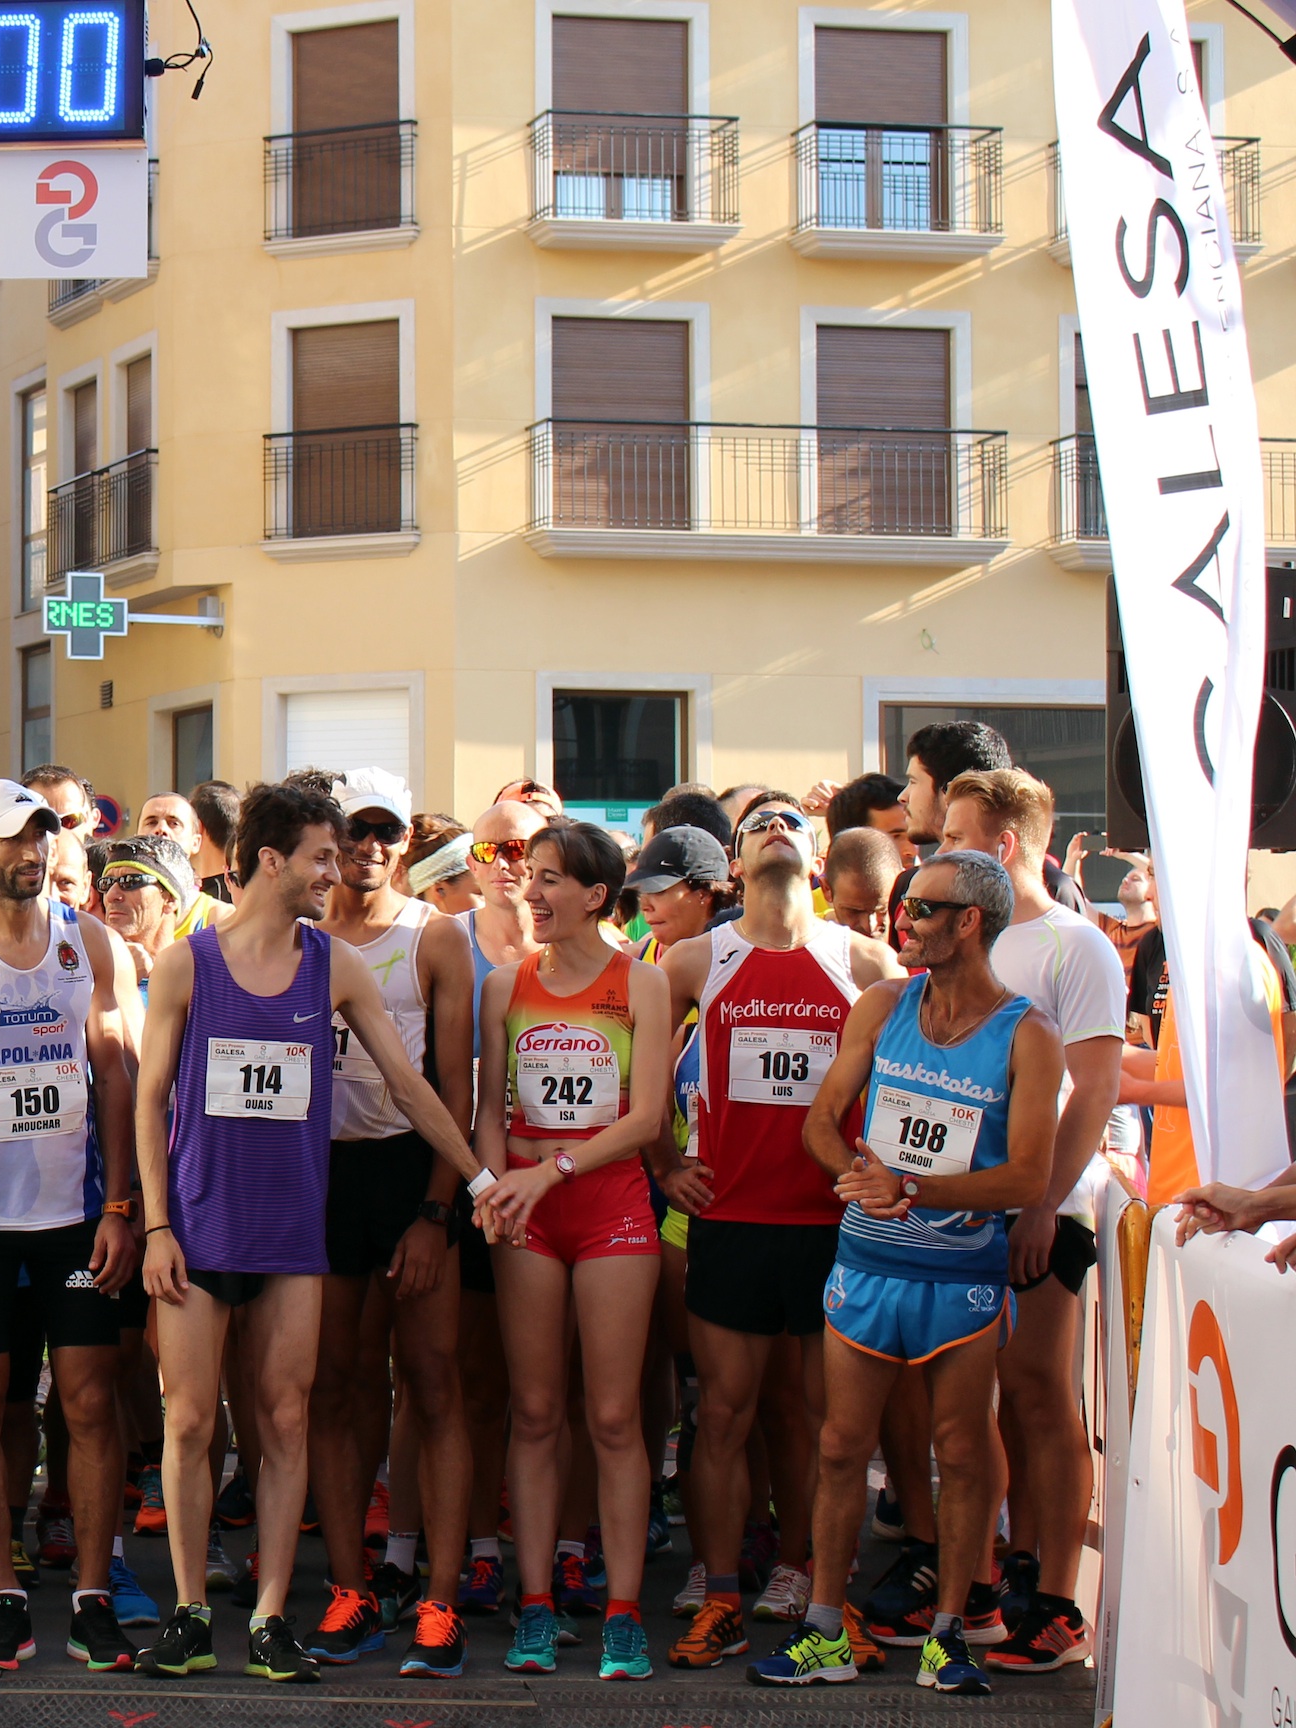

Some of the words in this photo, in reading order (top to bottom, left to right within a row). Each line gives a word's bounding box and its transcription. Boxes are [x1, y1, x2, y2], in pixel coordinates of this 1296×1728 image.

[591, 1003, 629, 1013] SERRANO
[720, 998, 841, 1024] Mediterránea
[32, 1023, 64, 1037] sport
[521, 1034, 601, 1051] Serrano
[737, 1036, 768, 1044] GALESA
[809, 1035, 833, 1047] 10K
[215, 1048, 245, 1056] GALESA
[285, 1046, 307, 1058] 10K
[589, 1056, 614, 1067] 10K
[759, 1051, 809, 1081] 103
[55, 1063, 79, 1075] 10K
[56, 1073, 80, 1081] CHESTE
[239, 1064, 282, 1094] 114
[874, 1055, 1004, 1103] maskokotas
[541, 1076, 593, 1105] 242
[772, 1085, 793, 1097] LUIS
[10, 1085, 60, 1117] 150
[245, 1098, 273, 1110] OUAIS
[559, 1110, 576, 1121] ISA
[882, 1095, 911, 1108] GALESA
[951, 1106, 976, 1122] 10K
[11, 1118, 61, 1133] AHOUCHAR
[949, 1116, 975, 1128] CHESTE
[899, 1116, 948, 1153] 198
[898, 1150, 933, 1168] CHAOUI
